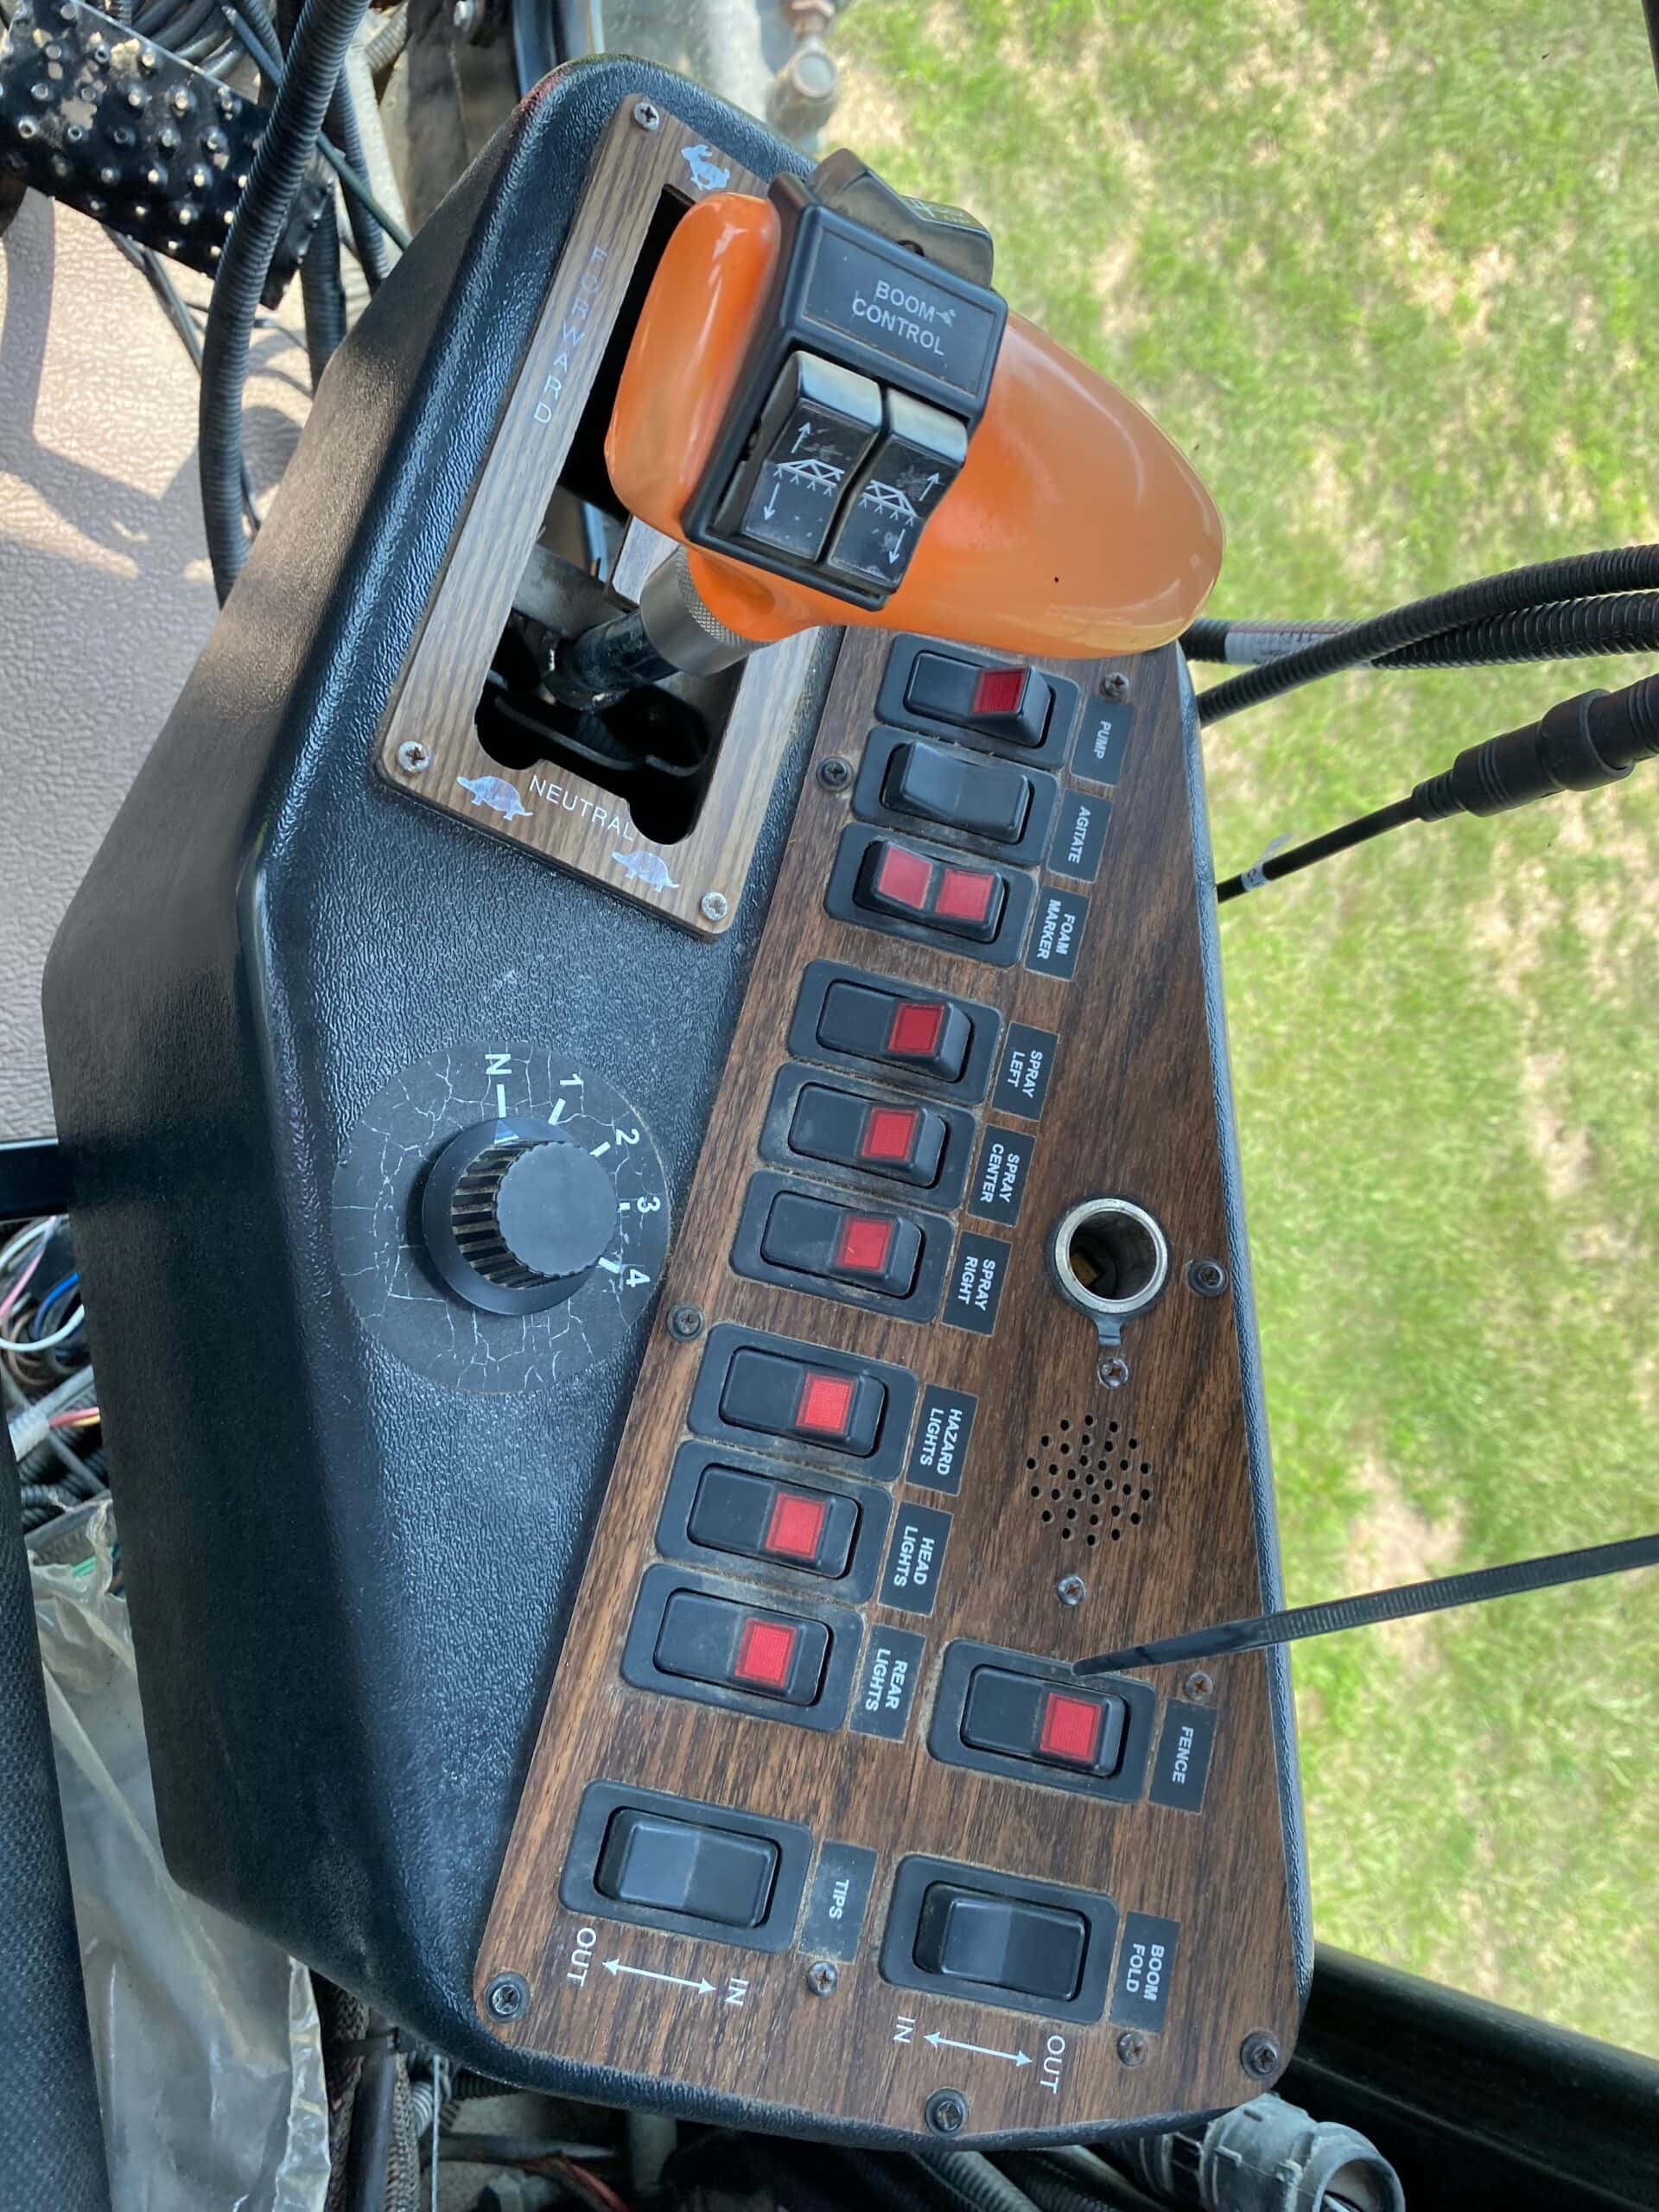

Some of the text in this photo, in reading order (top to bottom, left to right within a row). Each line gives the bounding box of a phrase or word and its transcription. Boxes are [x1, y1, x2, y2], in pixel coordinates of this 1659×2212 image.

[874, 279, 936, 323] BOOM
[532, 245, 607, 424] FORWARD
[851, 297, 945, 356] CONTROL
[1093, 721, 1112, 760] PUMP
[530, 774, 635, 842] NEUTRAL
[1068, 805, 1091, 864] AGITATE
[1036, 899, 1063, 960] MARKER
[1055, 914, 1077, 956] FOAM
[485, 1053, 512, 1075] N
[560, 1073, 584, 1086] 1
[1007, 1052, 1026, 1088] LEFT
[1023, 1050, 1044, 1098] SPRAY
[616, 1128, 640, 1146] 2
[979, 1144, 1005, 1203] CENTER
[1000, 1154, 1020, 1203] SPRAY
[637, 1196, 661, 1213] 3
[626, 1268, 651, 1287] 4
[957, 1255, 978, 1306] RIGHT
[977, 1259, 996, 1311] SPRAY
[920, 1408, 944, 1467] LIGHTS
[937, 1408, 963, 1476] HAZARD
[893, 1525, 918, 1587] LIGHTS
[913, 1537, 935, 1586] HEAD
[865, 1648, 891, 1713] LIGHTS
[884, 1661, 908, 1710] REAR
[1172, 1726, 1194, 1783] FENCE
[830, 1879, 849, 1920] TIPS
[566, 1927, 597, 1987] OUT
[1126, 1943, 1146, 1993] FOLD
[1143, 1943, 1165, 2001] BOOM
[724, 1977, 749, 2005] IN
[893, 2015, 916, 2044] IN
[1039, 2035, 1065, 2094] OUT
